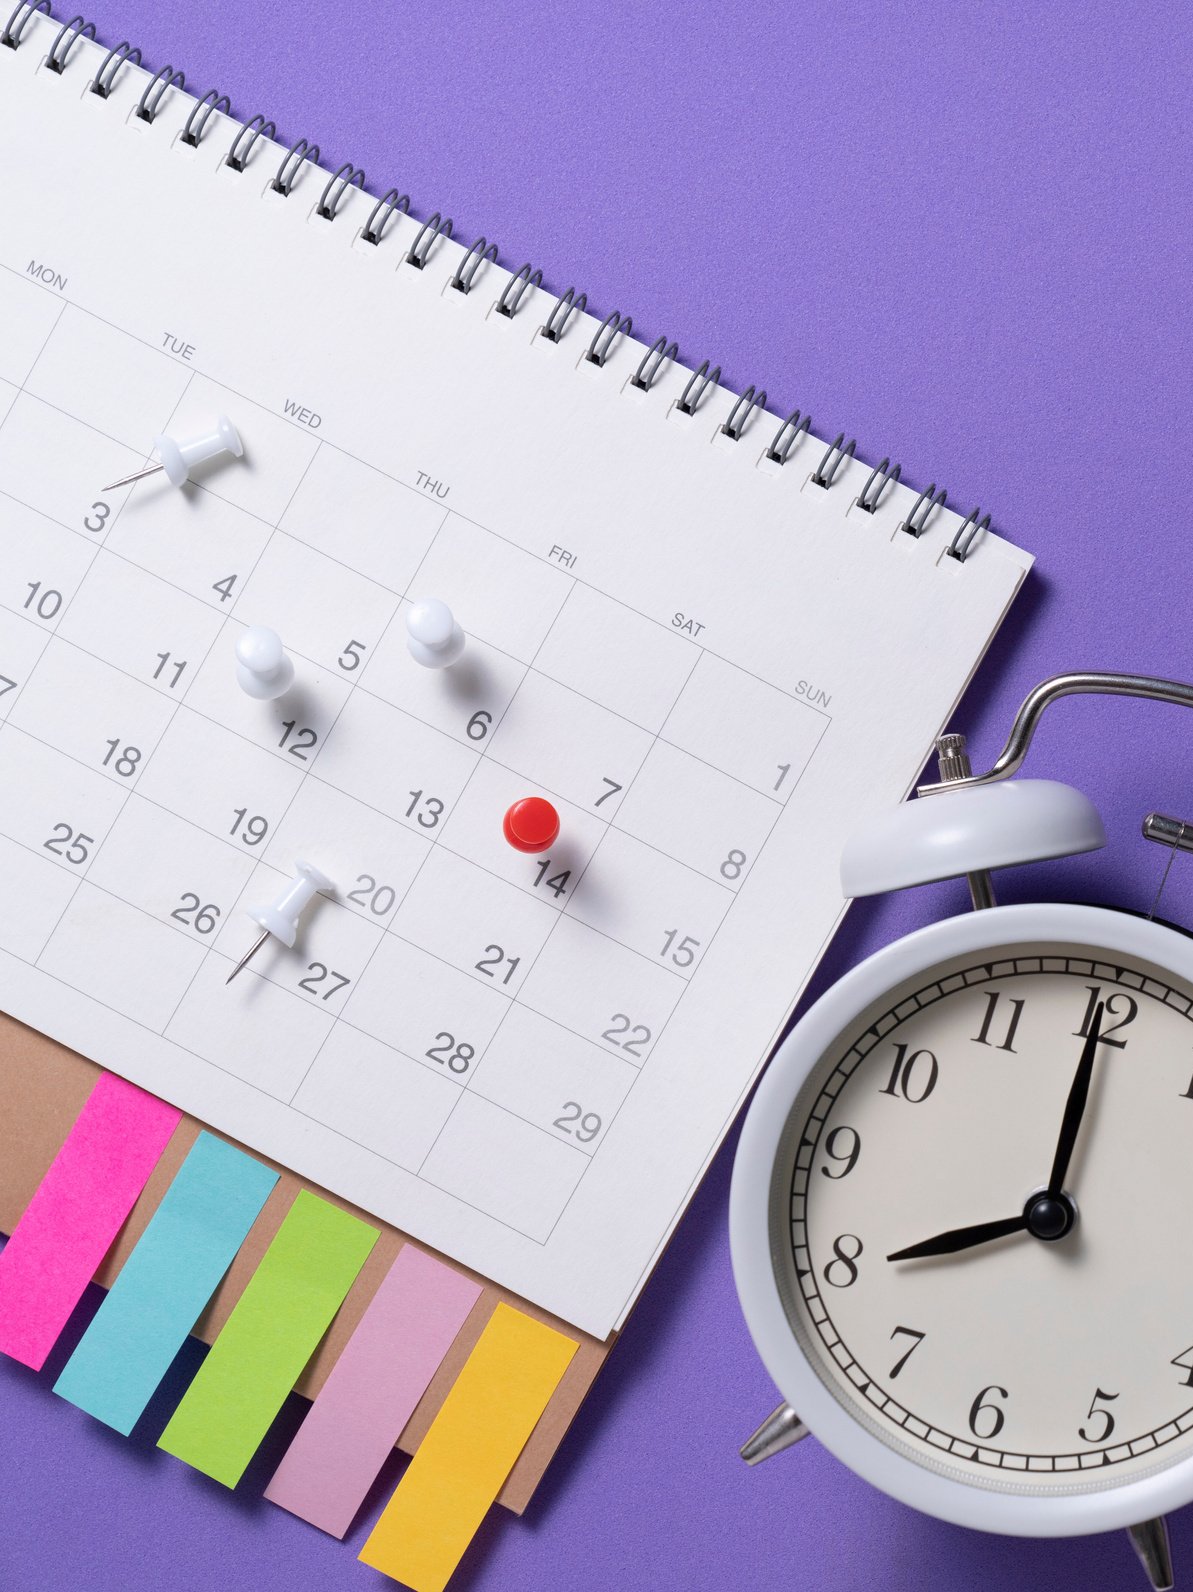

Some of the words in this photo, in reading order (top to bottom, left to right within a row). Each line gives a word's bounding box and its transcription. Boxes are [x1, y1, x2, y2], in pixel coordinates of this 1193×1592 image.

[26, 259, 69, 292] MON
[162, 331, 196, 361] TUE
[283, 398, 323, 430] WED
[414, 470, 451, 500] THU
[547, 544, 578, 570] FRI
[671, 612, 706, 638] SAT
[794, 680, 833, 709] SUN
[83, 501, 111, 533] 3
[211, 574, 238, 603] 4
[337, 639, 367, 672] 5
[465, 710, 493, 741] 6
[593, 776, 623, 808] 7
[719, 848, 747, 881] 8
[23, 581, 63, 620] 10
[152, 651, 188, 689] 11
[276, 719, 318, 761] 12
[404, 789, 445, 829] 13
[530, 859, 572, 899] 14
[660, 928, 701, 969] 15
[772, 763, 792, 792] 1
[102, 738, 142, 778] 18
[229, 807, 269, 846] 19
[346, 873, 397, 917] 20
[474, 944, 521, 985] 21
[600, 1012, 652, 1058] 22
[43, 822, 95, 865] 25
[170, 892, 221, 935] 26
[298, 961, 351, 1001] 27
[424, 1031, 475, 1074] 28
[552, 1100, 602, 1144] 29
[970, 991, 1026, 1054] 11
[1071, 985, 1139, 1050] 12
[878, 1043, 939, 1104] 10
[820, 1126, 861, 1180] 9
[823, 1233, 864, 1289] 8
[888, 1325, 927, 1380] 7
[968, 1385, 1009, 1440] 6
[1078, 1387, 1120, 1443] 5
